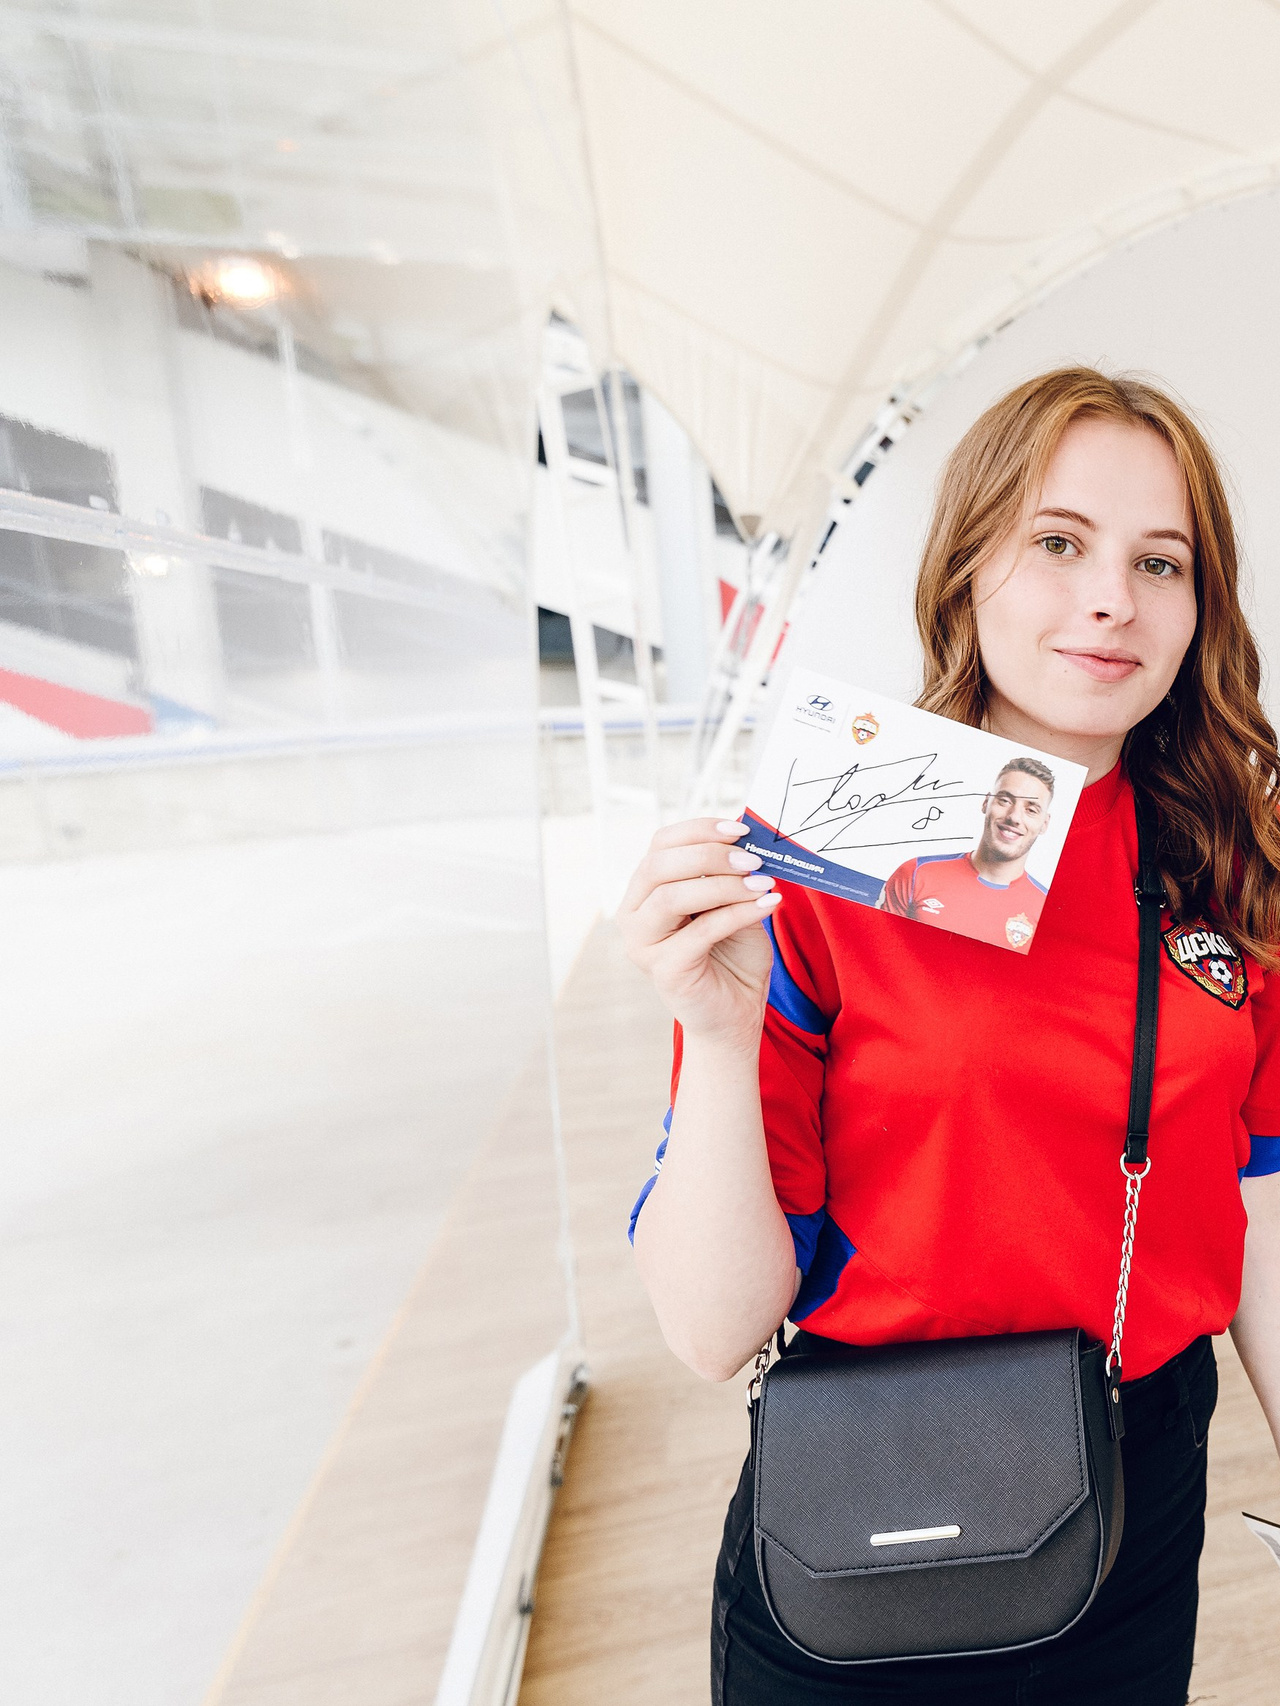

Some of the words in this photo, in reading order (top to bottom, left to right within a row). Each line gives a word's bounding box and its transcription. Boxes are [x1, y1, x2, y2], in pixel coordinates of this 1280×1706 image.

[795, 705, 837, 724] HYUNDAI
[744, 842, 784, 861] Никола
[1176, 931, 1237, 962] ЦСКА
